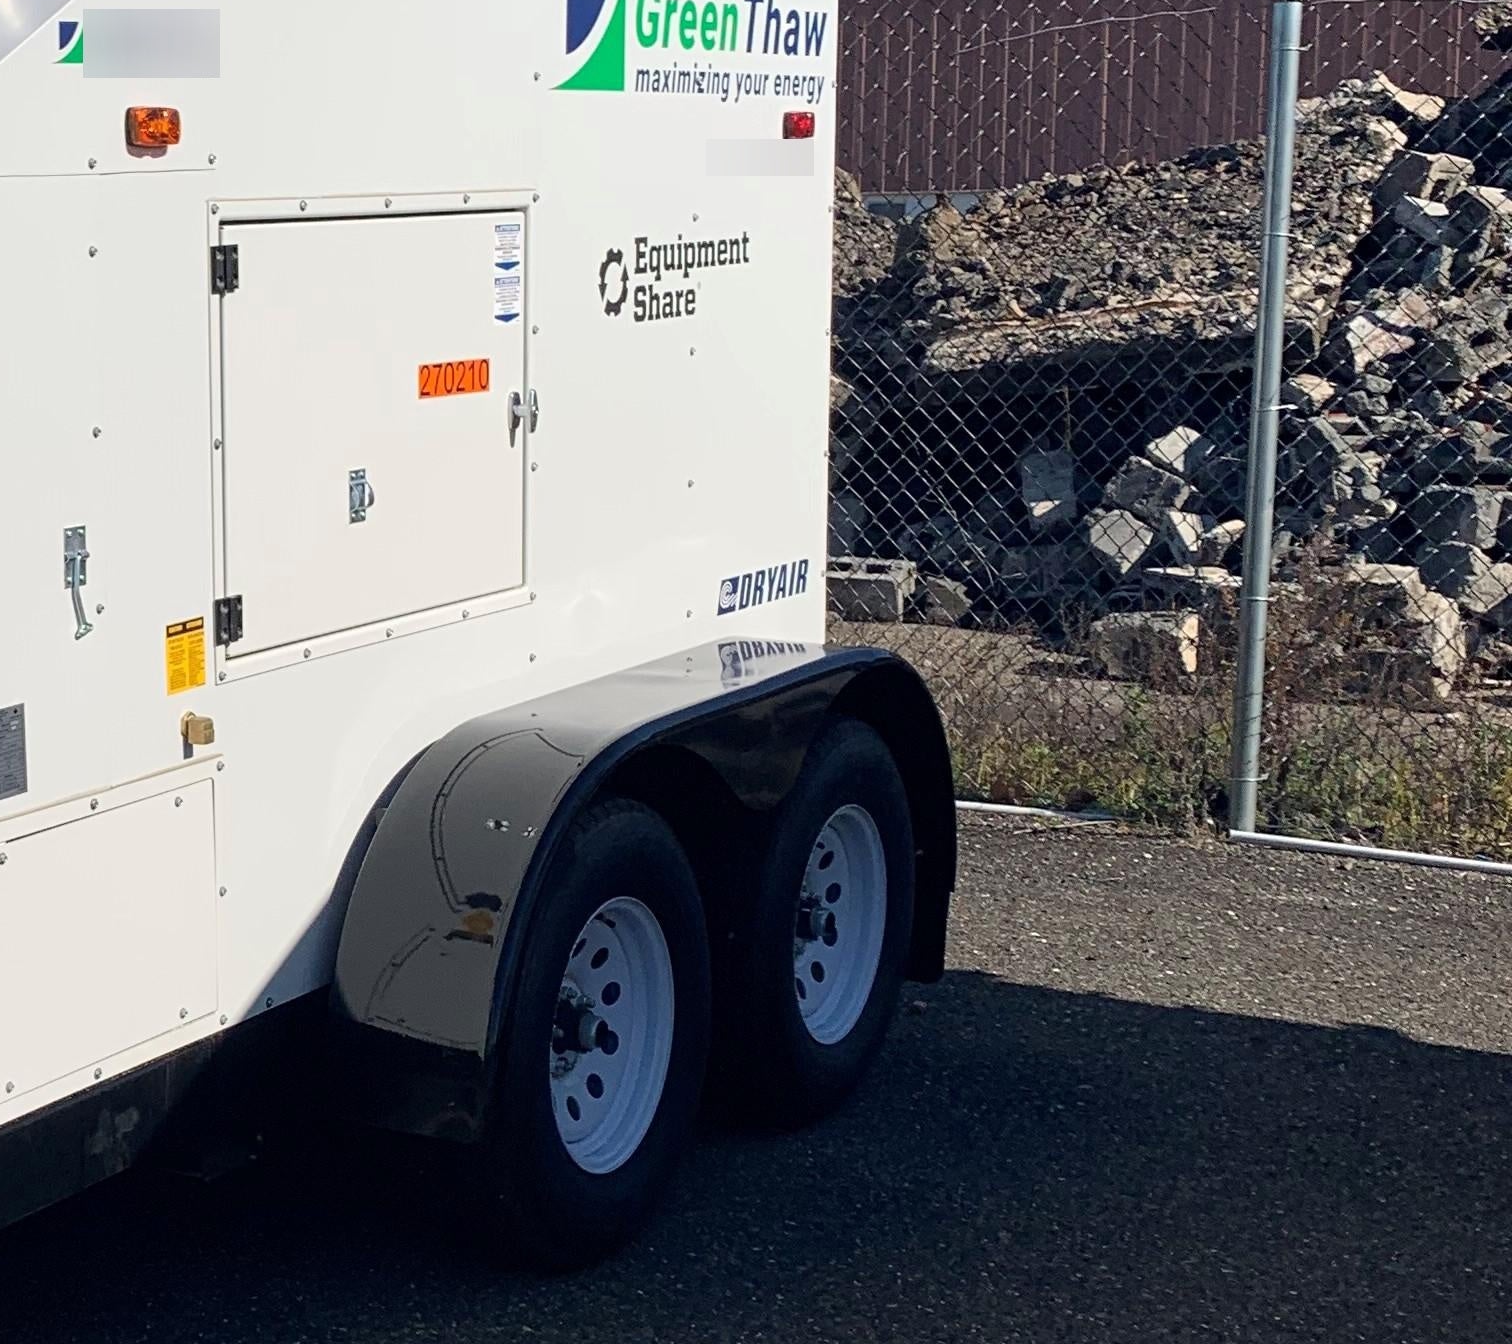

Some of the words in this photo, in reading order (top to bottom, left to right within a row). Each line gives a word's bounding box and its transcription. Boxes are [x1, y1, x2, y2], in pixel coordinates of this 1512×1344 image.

[635, 61, 731, 103] maximizing
[734, 72, 770, 104] your
[774, 72, 825, 105] energy
[634, 231, 750, 282] Equipment
[633, 284, 696, 323] Share
[420, 359, 489, 396] 270210
[738, 558, 809, 611] DRYAIR
